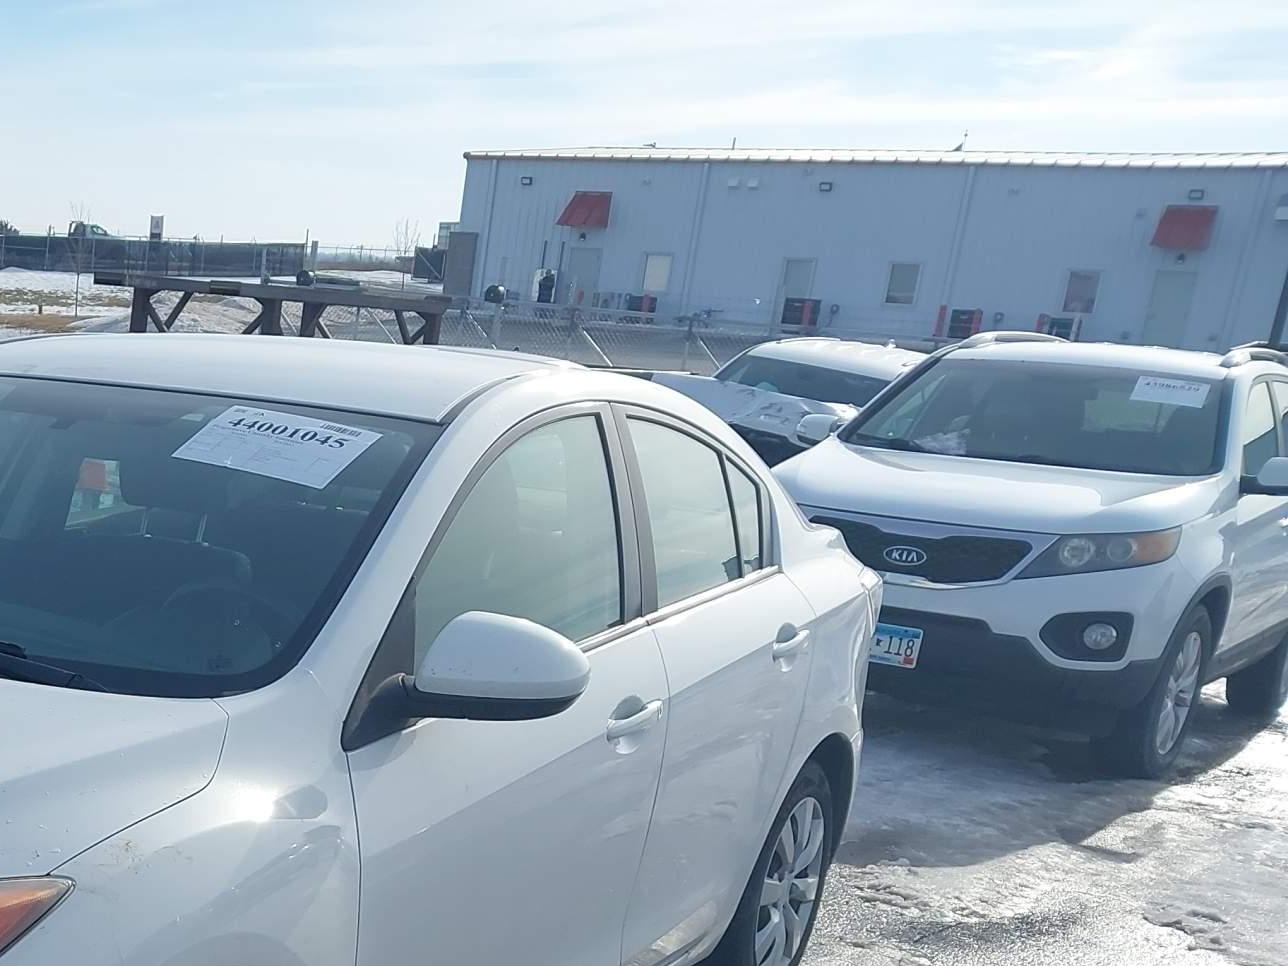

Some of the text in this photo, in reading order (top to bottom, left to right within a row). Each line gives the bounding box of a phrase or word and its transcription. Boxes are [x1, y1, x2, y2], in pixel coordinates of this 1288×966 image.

[228, 417, 351, 449] 44001045
[891, 549, 917, 562] KIA
[883, 635, 915, 657] 118
